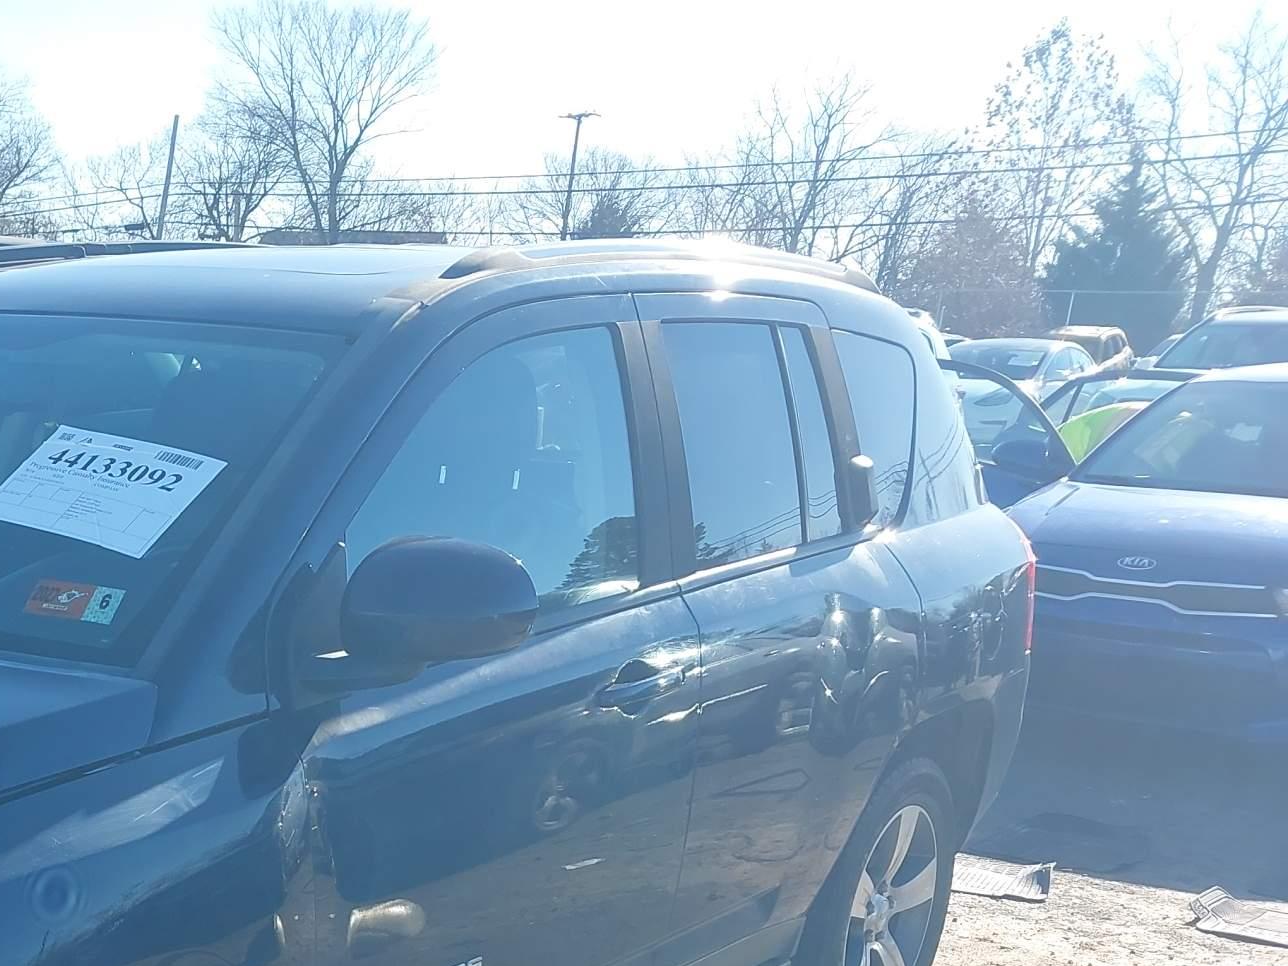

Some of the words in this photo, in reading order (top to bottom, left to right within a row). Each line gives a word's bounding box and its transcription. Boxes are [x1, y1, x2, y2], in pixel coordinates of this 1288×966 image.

[47, 447, 184, 492] 44133092
[1123, 556, 1150, 567] KIA
[99, 594, 113, 610] 6
